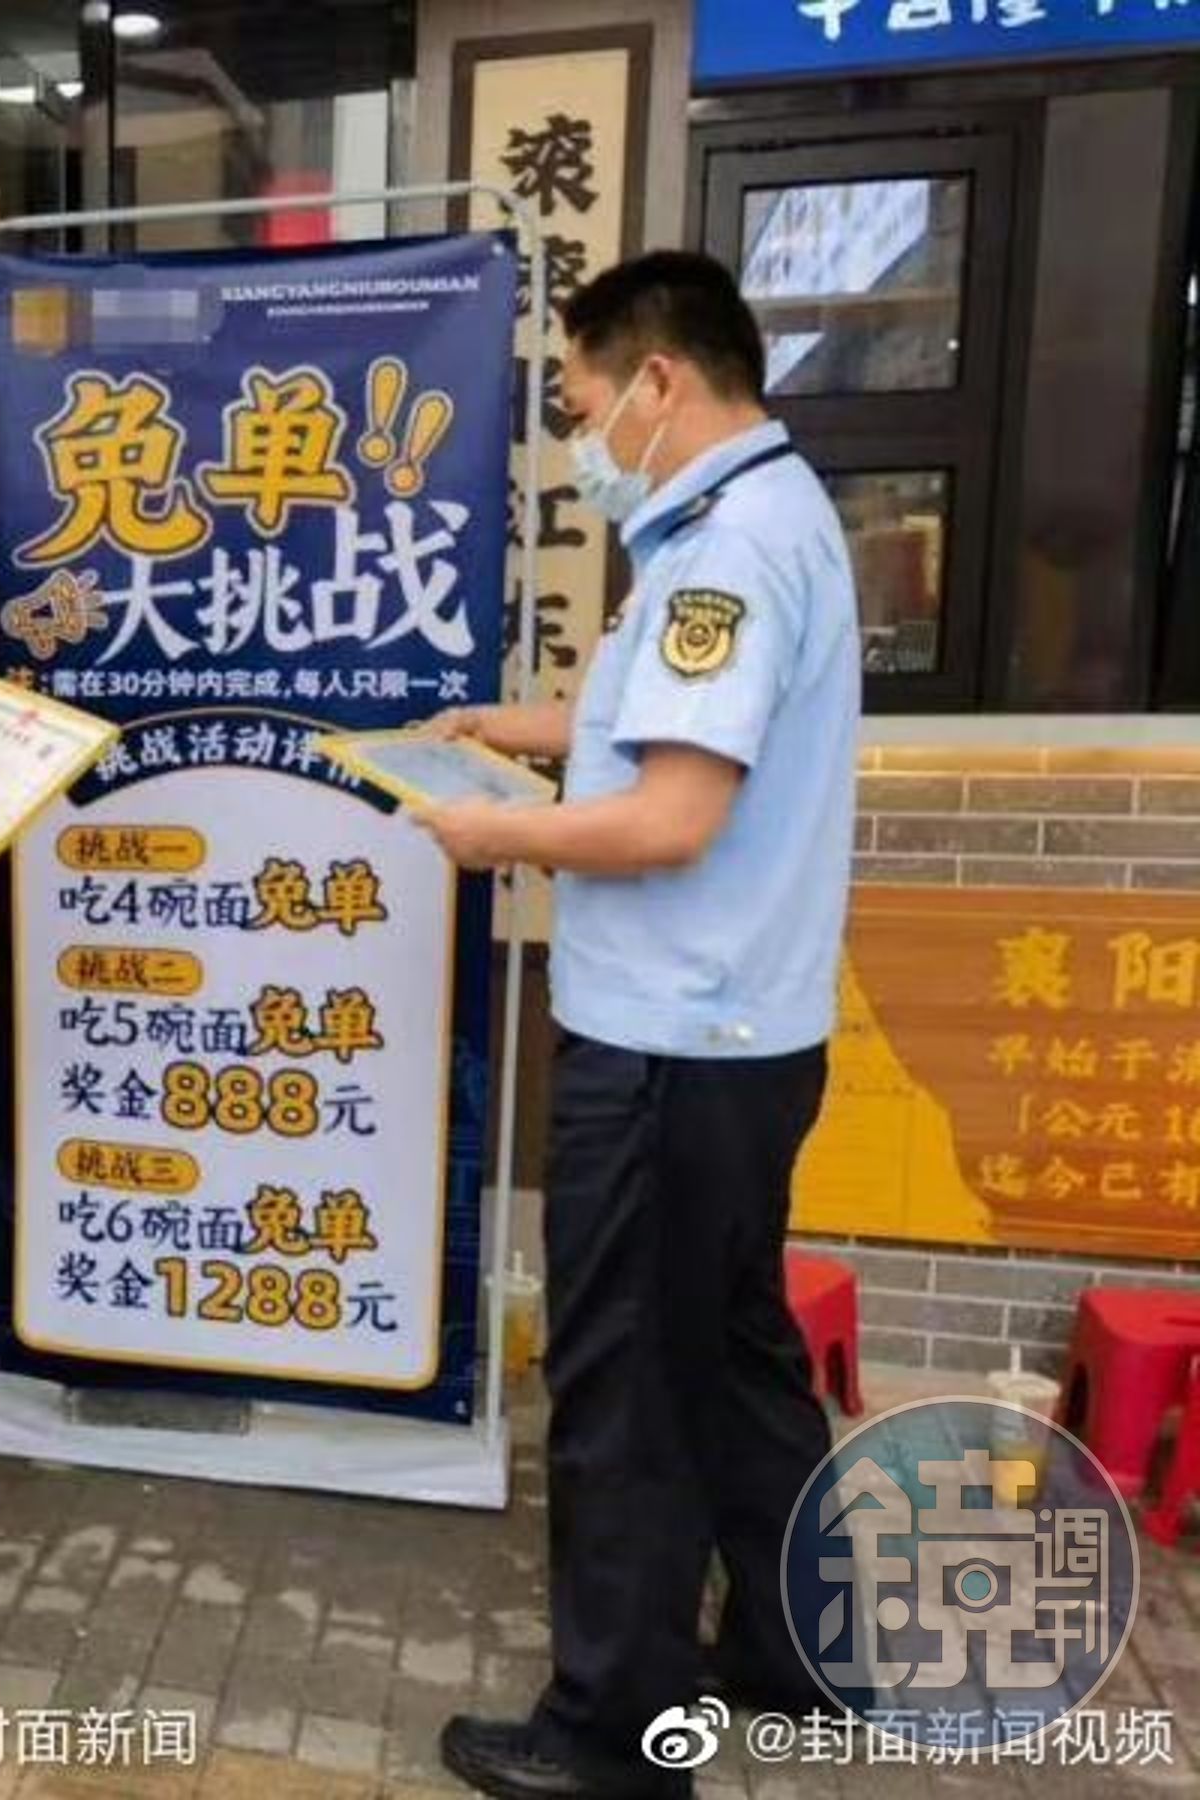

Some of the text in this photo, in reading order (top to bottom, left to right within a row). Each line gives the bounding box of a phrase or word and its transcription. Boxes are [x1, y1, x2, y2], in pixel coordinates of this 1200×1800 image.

[100, 501, 475, 664] 大挑战
[77, 829, 188, 865] 挑战一
[76, 949, 185, 987] 挑战二
[61, 1061, 377, 1137] 奖金888元
[75, 1145, 180, 1186] 挑战三
[58, 1251, 398, 1333] 奖金1288元
